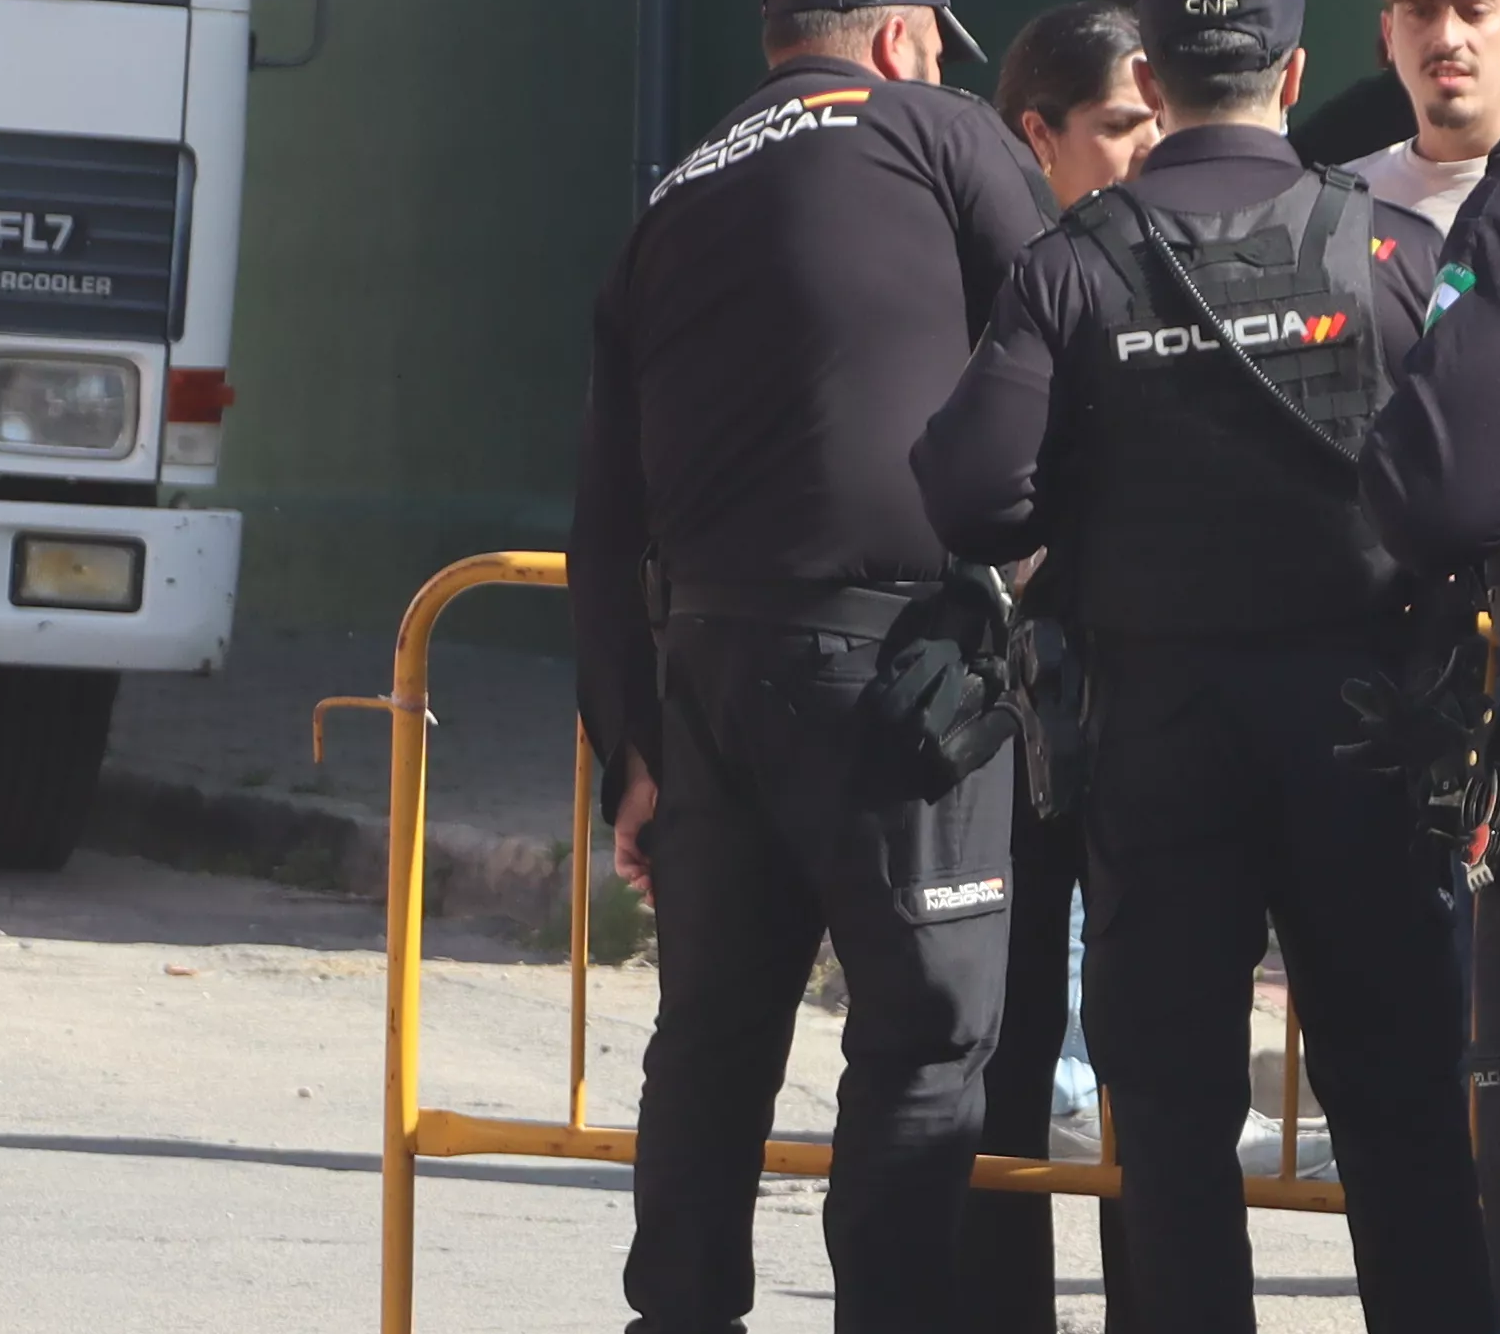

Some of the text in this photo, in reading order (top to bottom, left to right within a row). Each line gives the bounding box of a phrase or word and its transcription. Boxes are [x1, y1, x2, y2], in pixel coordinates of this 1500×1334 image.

[1116, 310, 1310, 362] POLICIA
[923, 880, 990, 900] POLICIA
[926, 888, 1005, 911] NACIONAL
